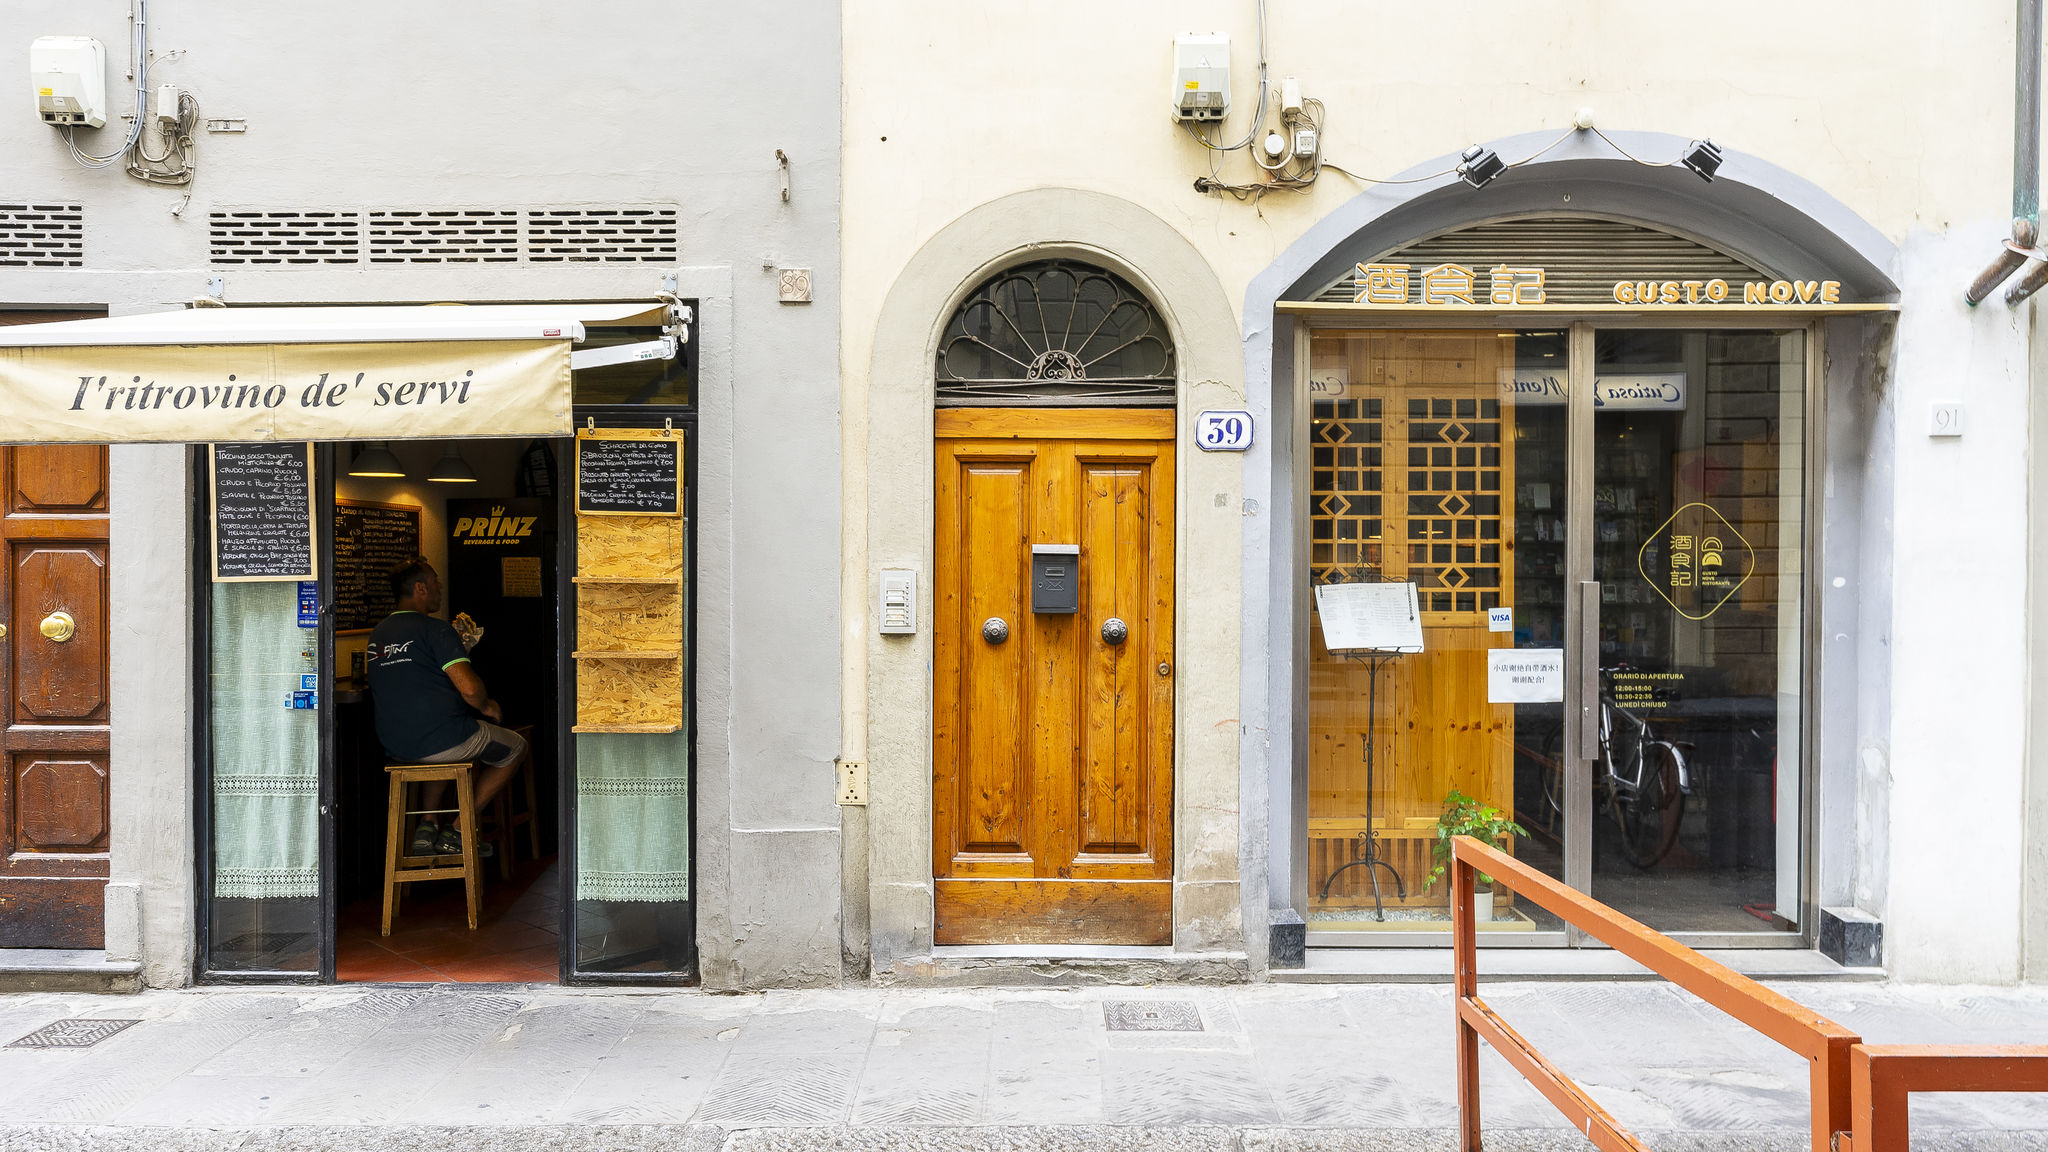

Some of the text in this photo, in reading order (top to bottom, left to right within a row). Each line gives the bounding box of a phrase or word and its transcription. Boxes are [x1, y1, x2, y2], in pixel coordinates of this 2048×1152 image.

[1354, 262, 1546, 304] 酒食記
[1613, 279, 1840, 303] GUSTO NOVE
[300, 373, 365, 408] de'
[373, 370, 474, 406] servi
[1208, 418, 1242, 444] 39
[453, 516, 538, 537] PRINZ
[1670, 535, 1692, 587] 酒食記
[1491, 614, 1510, 622] VISA
